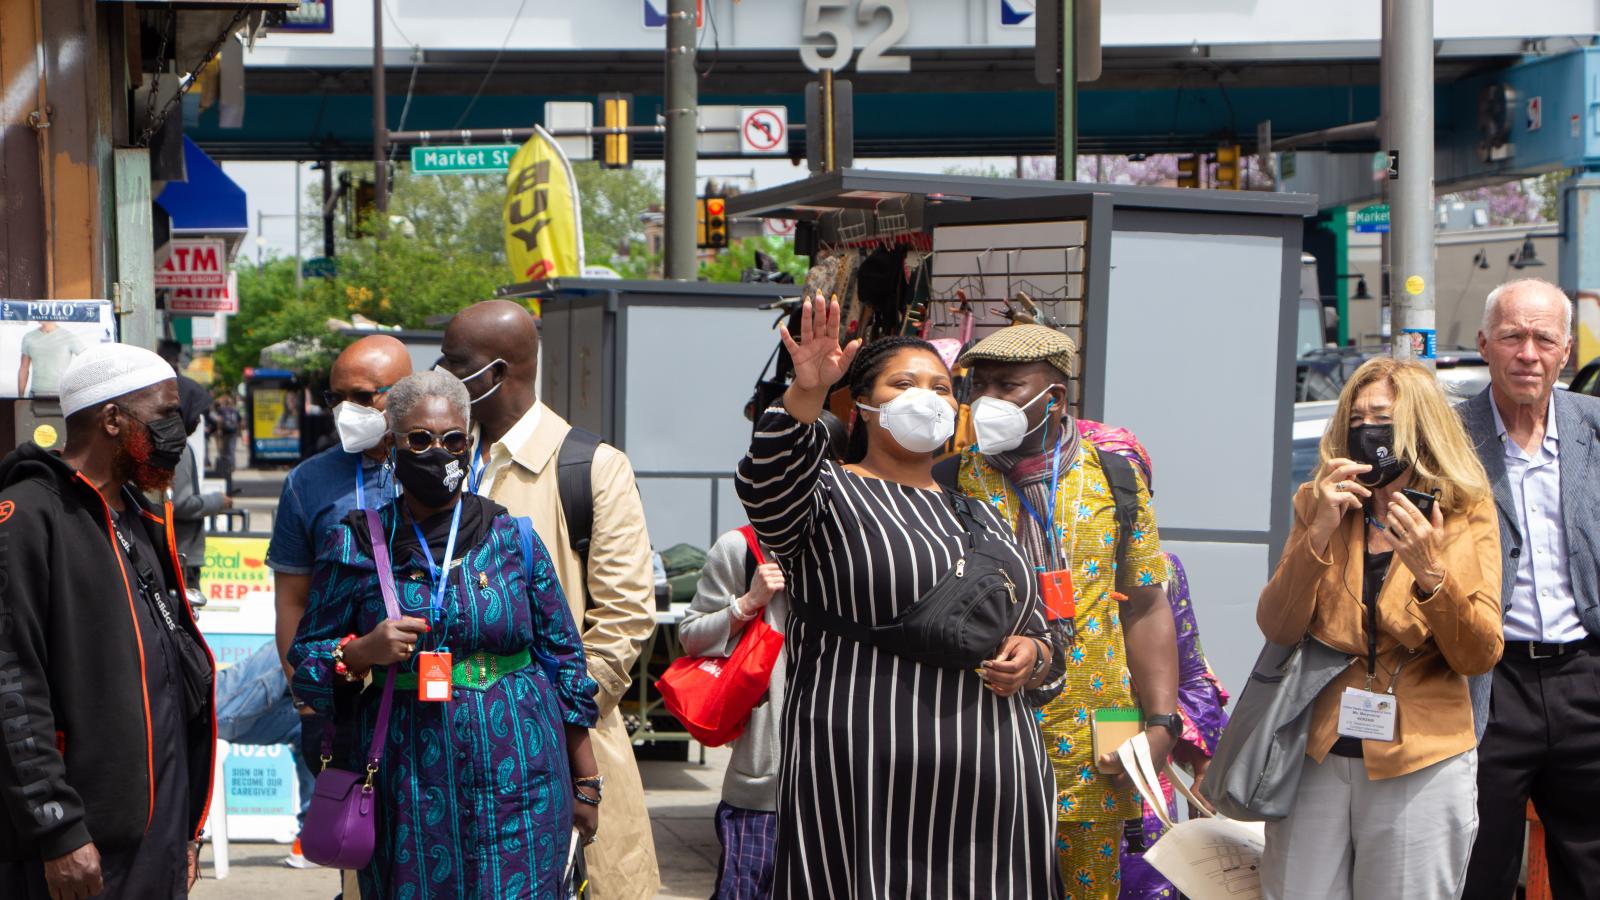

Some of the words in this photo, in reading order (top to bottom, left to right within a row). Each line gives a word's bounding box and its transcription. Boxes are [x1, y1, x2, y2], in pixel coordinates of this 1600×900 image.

[799, 0, 912, 74] 52
[424, 150, 485, 167] Market
[492, 150, 509, 166] St
[27, 302, 74, 316] POLO
[205, 551, 240, 569] otal
[199, 571, 264, 580] WIRELESS
[154, 592, 176, 631] adidas
[232, 768, 250, 777] SIGN
[253, 768, 264, 777] ON
[267, 768, 277, 777] TO
[231, 777, 264, 787] BECOME
[266, 777, 283, 787] OUR
[231, 787, 277, 796] CAREGIVER
